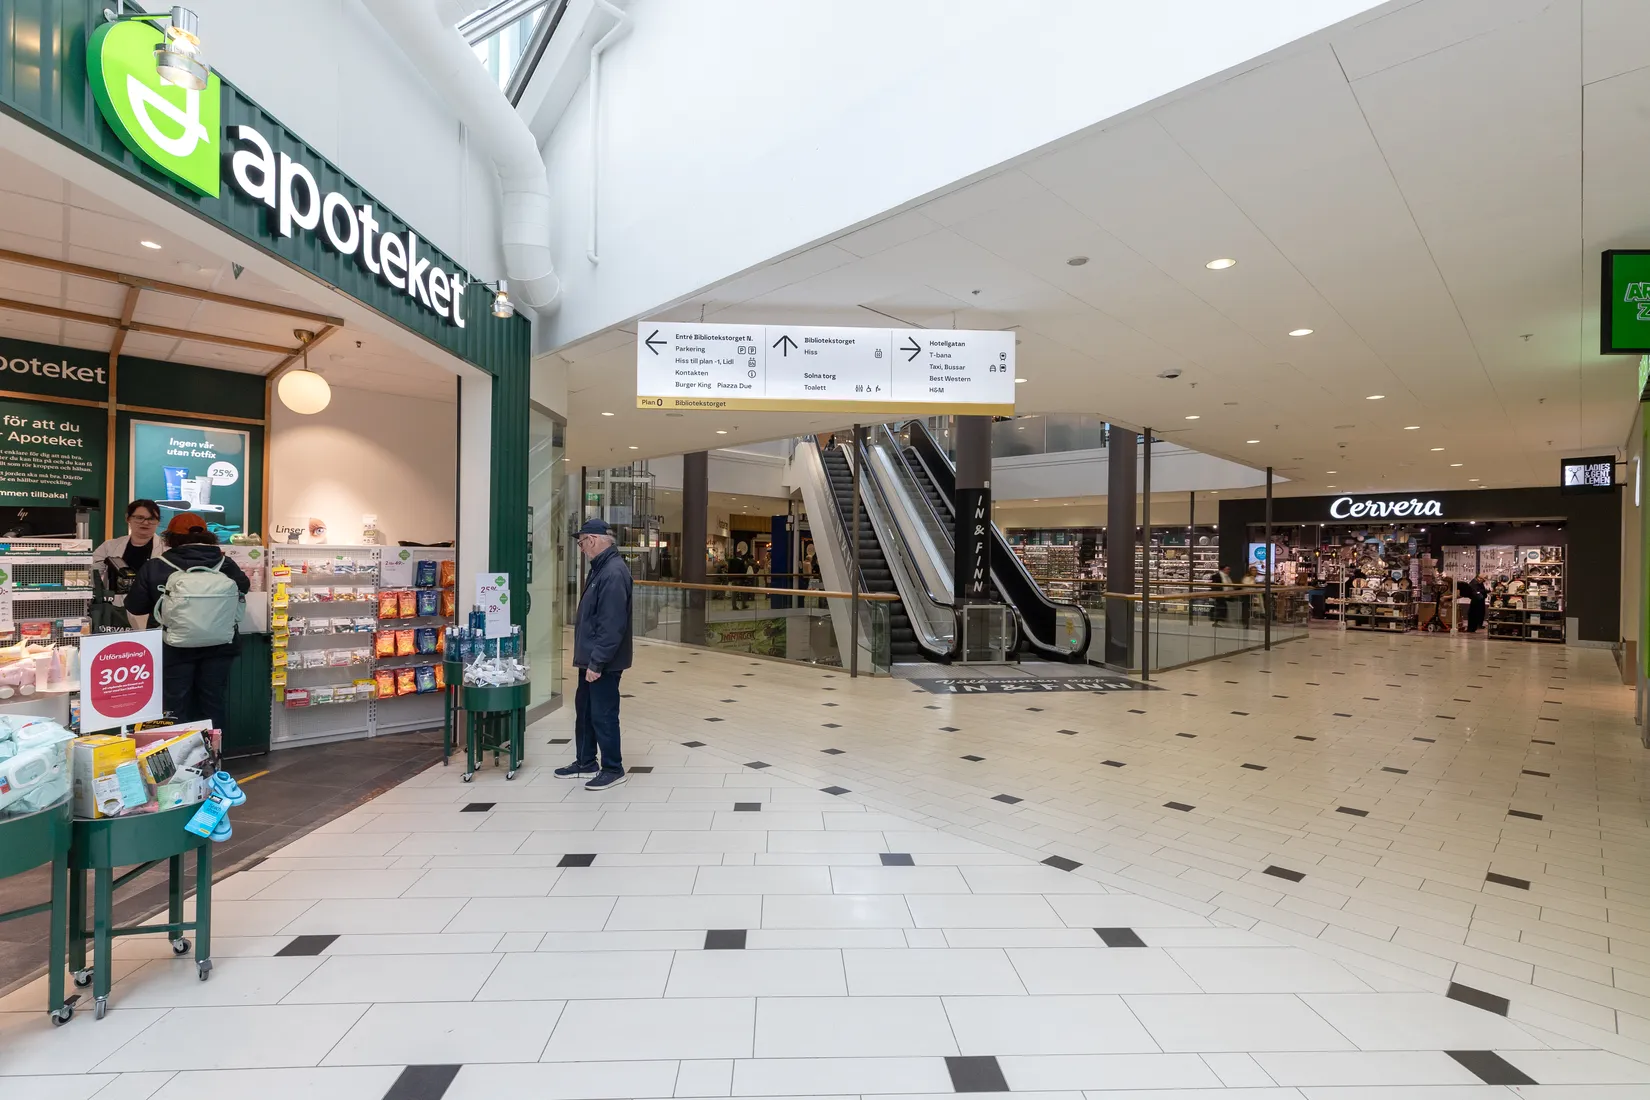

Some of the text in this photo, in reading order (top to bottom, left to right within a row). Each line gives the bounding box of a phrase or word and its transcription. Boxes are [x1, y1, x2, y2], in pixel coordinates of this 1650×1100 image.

[232, 124, 464, 328] apoteket
[694, 334, 746, 342] Bibliotekstorget
[804, 337, 855, 345] Bibliotekstorget
[675, 400, 726, 408] Bibliotekstorget
[4, 415, 80, 432] för att du
[8, 431, 83, 447] Apoteket
[170, 438, 214, 449] Ingen vår
[191, 450, 216, 459] fotfix
[1584, 463, 1610, 471] LADIES
[213, 469, 234, 478] 25%
[31, 491, 68, 499] tillbaka!
[1330, 497, 1443, 518] Cervera
[276, 525, 305, 535] Linser
[974, 495, 985, 592] IN & FINN
[100, 650, 146, 660] Utförsäljning!
[99, 664, 150, 685] 30%
